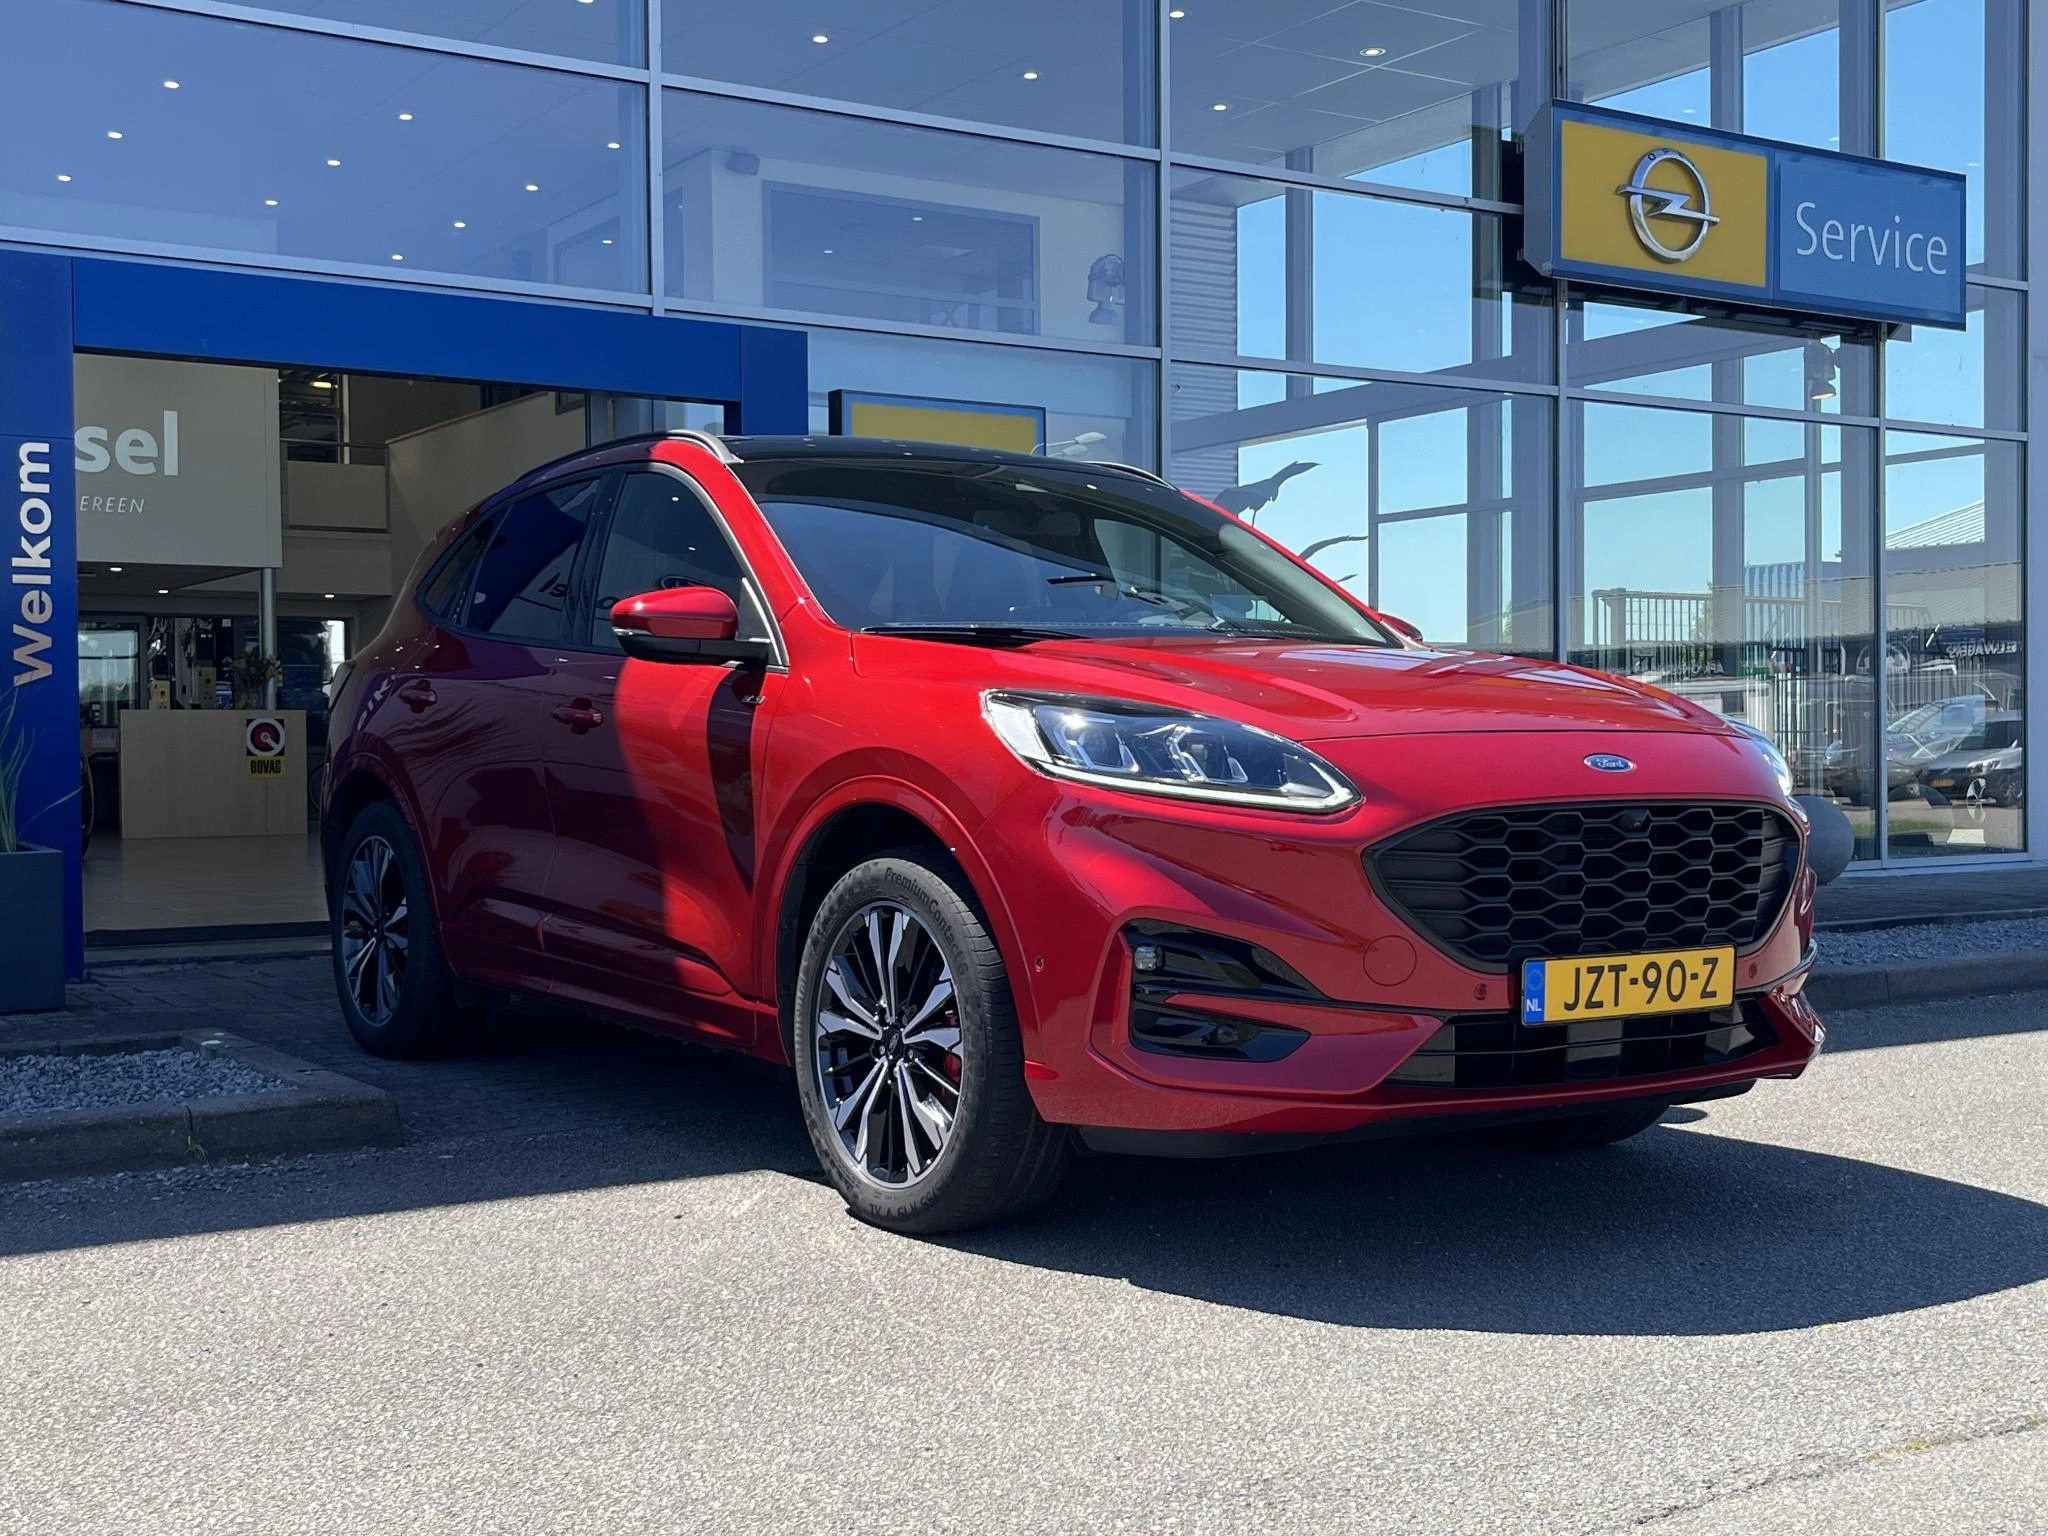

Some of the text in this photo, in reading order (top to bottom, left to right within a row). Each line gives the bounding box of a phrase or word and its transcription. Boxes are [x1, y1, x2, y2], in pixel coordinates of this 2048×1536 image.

[1796, 201, 1948, 275] Service
[74, 409, 178, 475] sel
[80, 495, 145, 513] EREEN
[12, 441, 53, 687] Welkom
[250, 759, 282, 775] BOVAG
[1526, 998, 1542, 1013] NL
[1563, 957, 1719, 1012] JZT-90-Z
